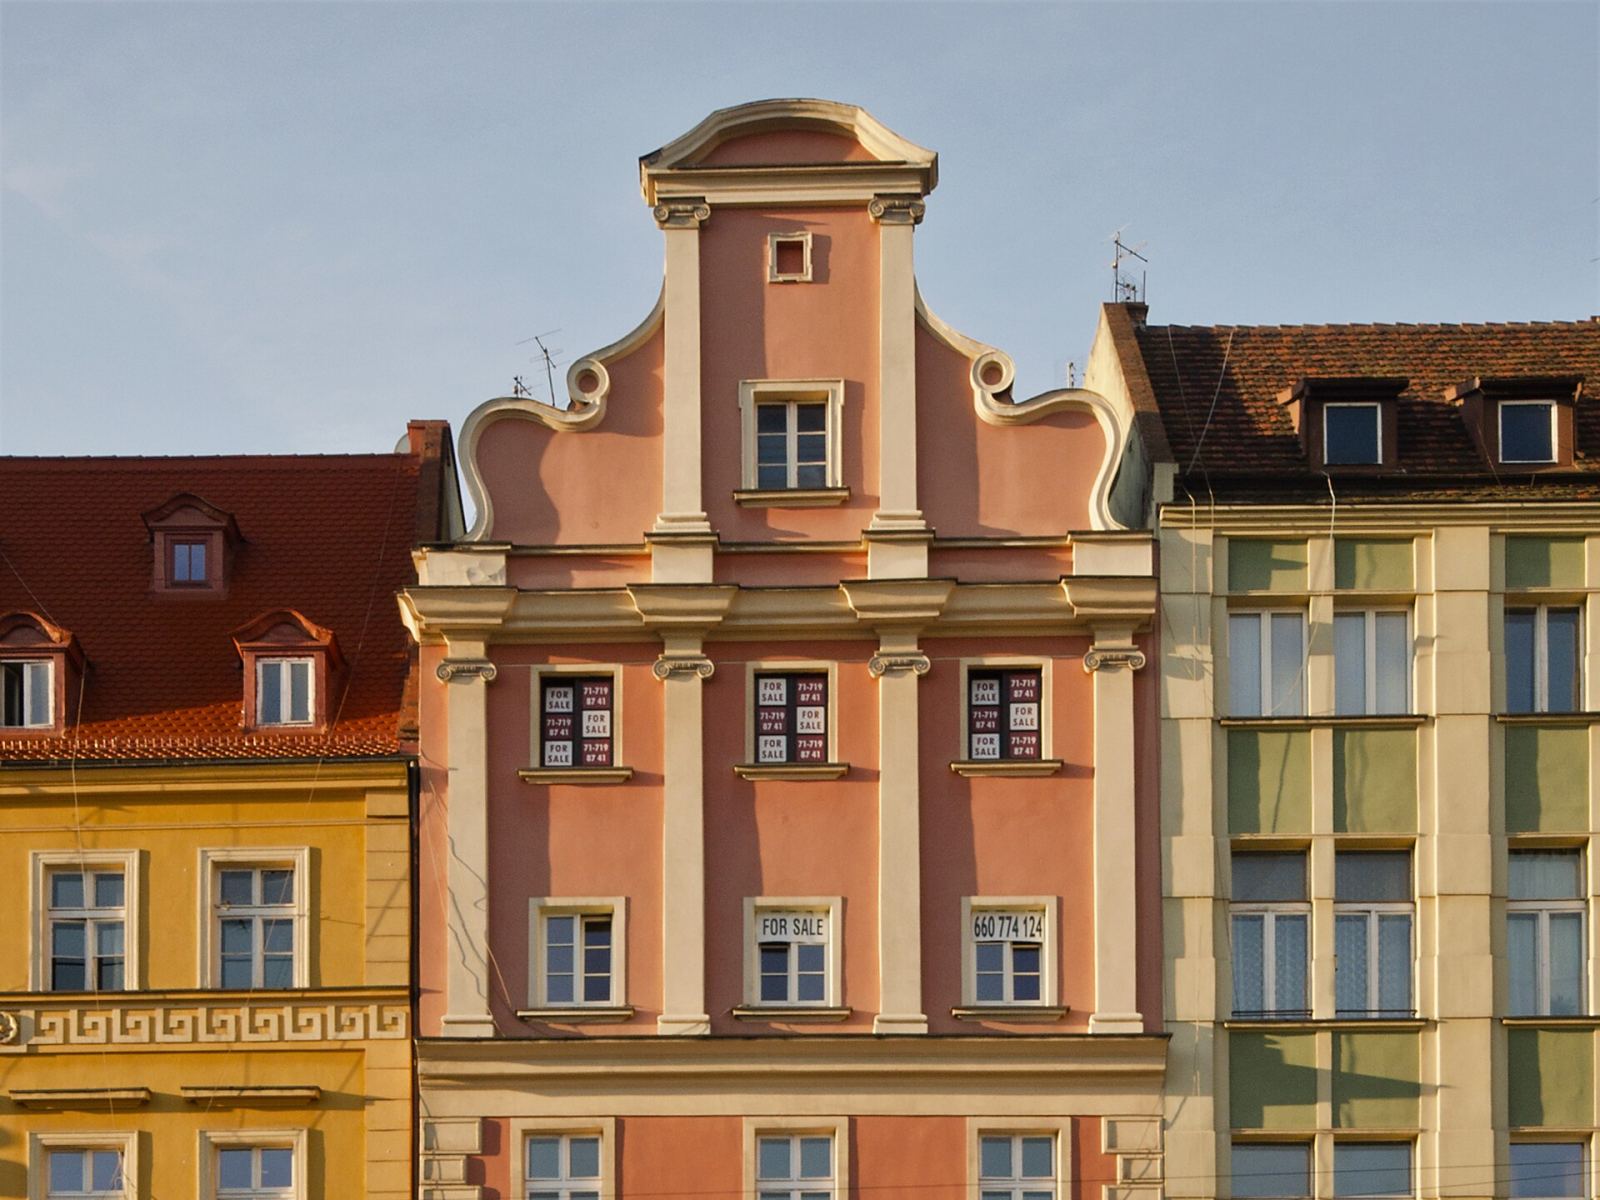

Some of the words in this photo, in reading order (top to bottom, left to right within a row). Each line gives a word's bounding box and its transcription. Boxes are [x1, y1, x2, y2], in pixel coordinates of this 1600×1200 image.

[764, 682, 782, 690] FOR
[798, 683, 823, 691] 71-719
[976, 683, 995, 691] FOR
[550, 690, 569, 699] FOR
[583, 687, 609, 695] 71-719
[586, 697, 596, 705] 87
[596, 697, 606, 705] 41
[762, 693, 784, 702] SALE
[974, 694, 996, 702] SALE
[548, 700, 570, 709] SALE
[802, 710, 820, 719] FOR
[973, 711, 998, 719] 71-719
[1015, 707, 1033, 715] FOR
[588, 714, 605, 723] FOR
[760, 712, 785, 720] 71-719
[800, 721, 821, 730] SALE
[1013, 718, 1035, 727] SALE
[585, 725, 607, 734] SALE
[764, 739, 782, 748] FOR
[798, 740, 823, 748] 71-719
[976, 737, 995, 745] FOR
[550, 744, 568, 752] FOR
[974, 747, 997, 756] SALE
[1014, 747, 1023, 755] 87
[1024, 747, 1034, 755] 41
[586, 754, 596, 762] 87
[596, 754, 606, 762] 41
[761, 750, 784, 759] SALE
[548, 755, 569, 763] SALE
[762, 918, 787, 936] FOR
[793, 918, 824, 936] SALE
[974, 916, 995, 938] 660
[998, 916, 1019, 938] 774
[1023, 916, 1042, 938] 124
